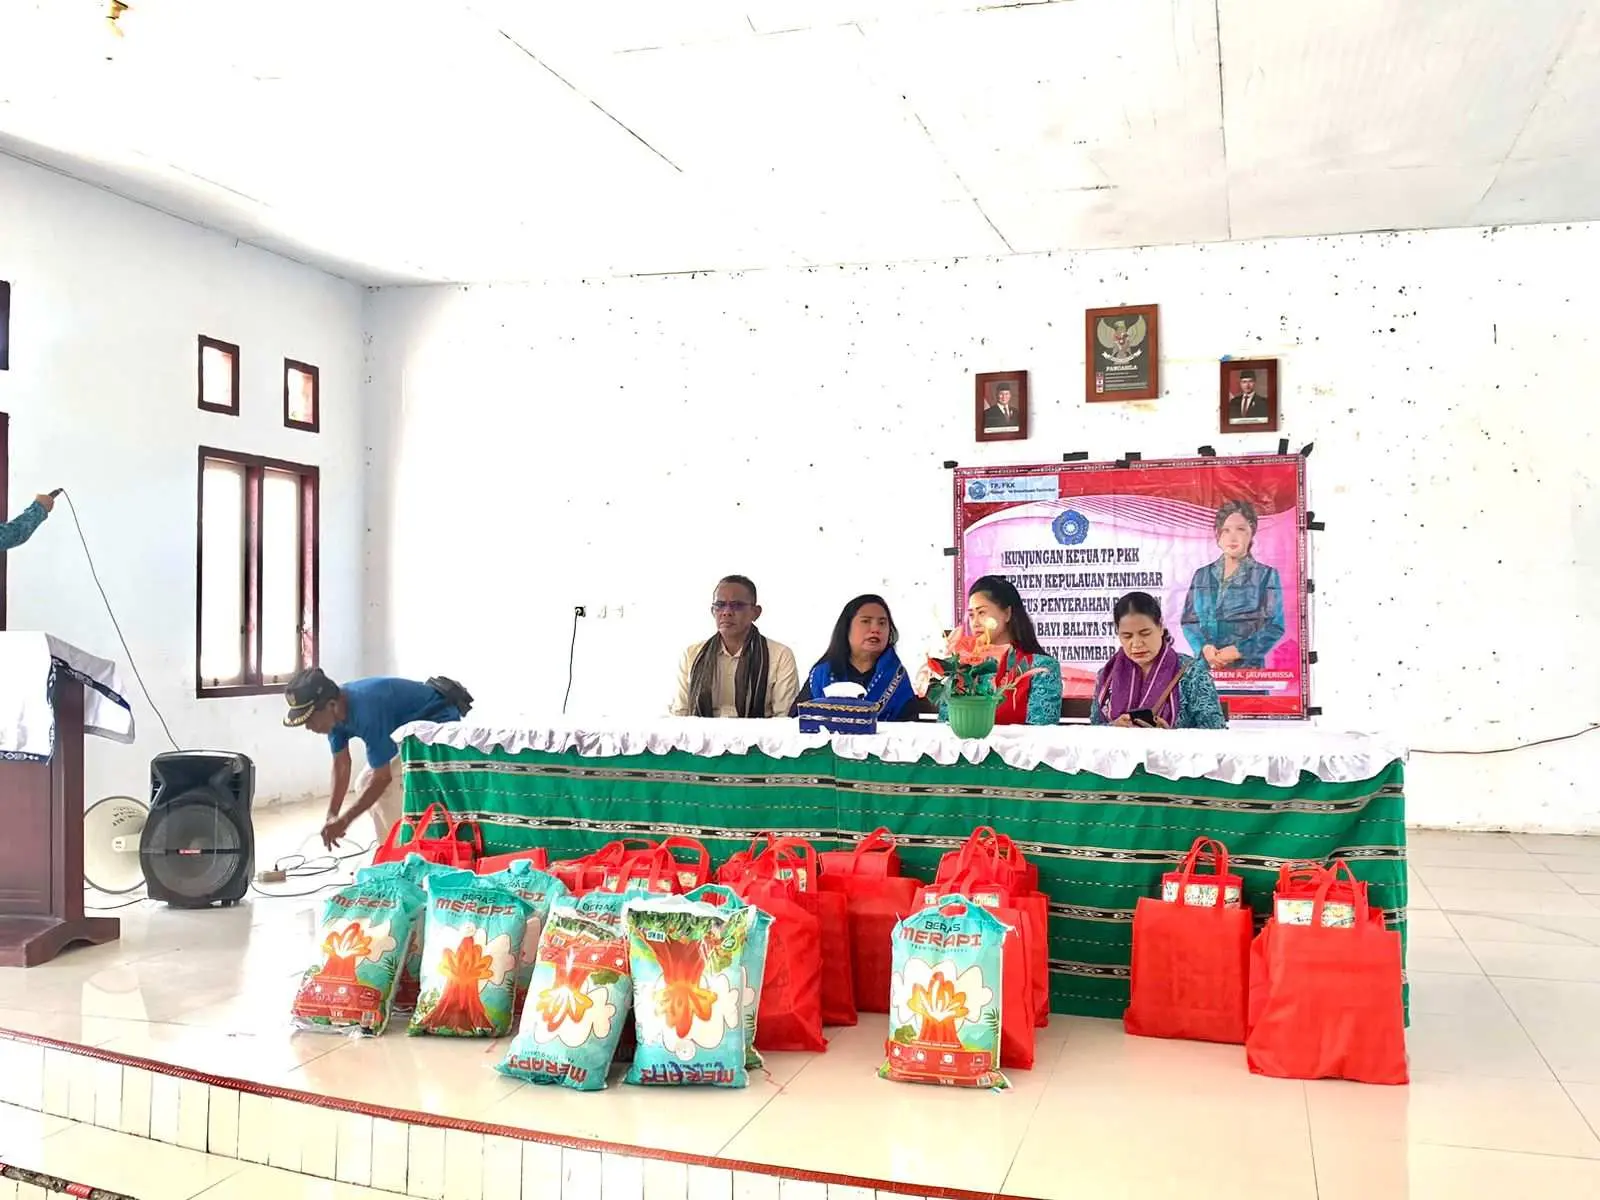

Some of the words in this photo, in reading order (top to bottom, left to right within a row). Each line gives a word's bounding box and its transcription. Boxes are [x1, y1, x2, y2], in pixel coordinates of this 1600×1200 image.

[1004, 550, 1064, 568] KUNJUNGAN
[1066, 549, 1101, 564] KETUA
[1117, 548, 1140, 563] PKK
[1044, 573, 1105, 588] KEPULAUAN
[1107, 572, 1163, 587] TANIMBAR
[1040, 597, 1110, 612] PENYERAHAN
[1037, 621, 1060, 636] BAYI
[1063, 621, 1100, 636] BALITA
[437, 898, 517, 915] MERAPI
[925, 921, 961, 934] BERAS
[899, 927, 982, 947] MERAPI
